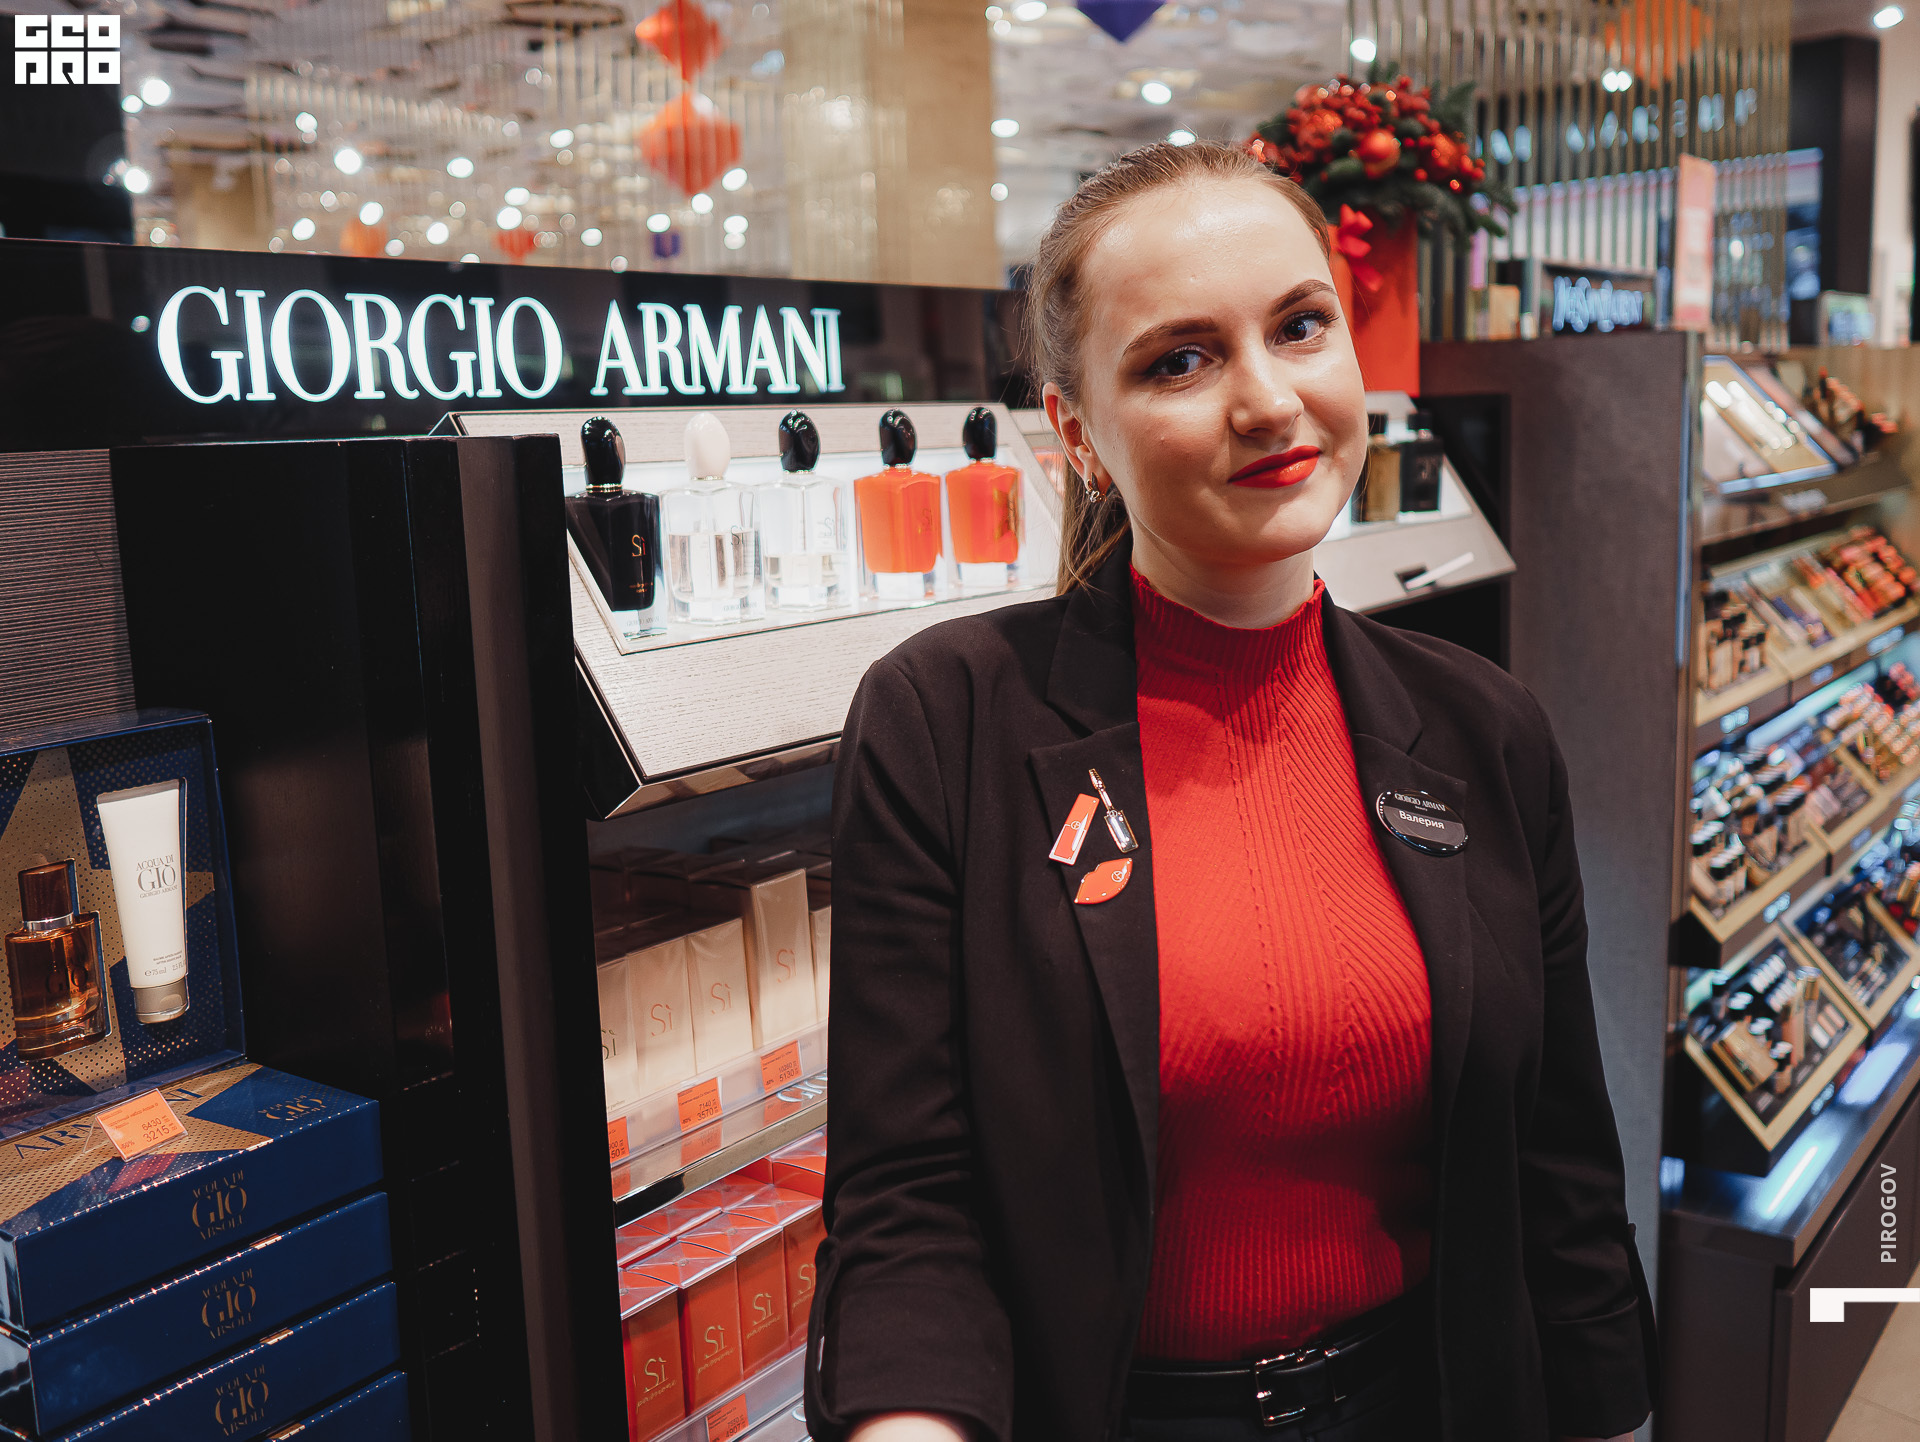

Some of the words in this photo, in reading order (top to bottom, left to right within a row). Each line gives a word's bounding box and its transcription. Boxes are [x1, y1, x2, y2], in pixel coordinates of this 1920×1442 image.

[157, 285, 563, 404] GIORGIO
[591, 299, 846, 396] ARMANI
[1395, 793, 1420, 805] GIORGIO
[1421, 800, 1446, 812] ARMANI
[1399, 810, 1445, 830] Валерия
[136, 857, 165, 872] ACQUA
[165, 854, 174, 864] DI
[776, 949, 798, 984] Sì
[711, 982, 733, 1015] Sì
[651, 1003, 674, 1037] Sì
[141, 1117, 162, 1131] 6430
[697, 1107, 714, 1121] 3570
[143, 1125, 170, 1142] 3215
[752, 1293, 773, 1325] Sì
[704, 1325, 726, 1359] Sì
[644, 1357, 667, 1392] Sì
